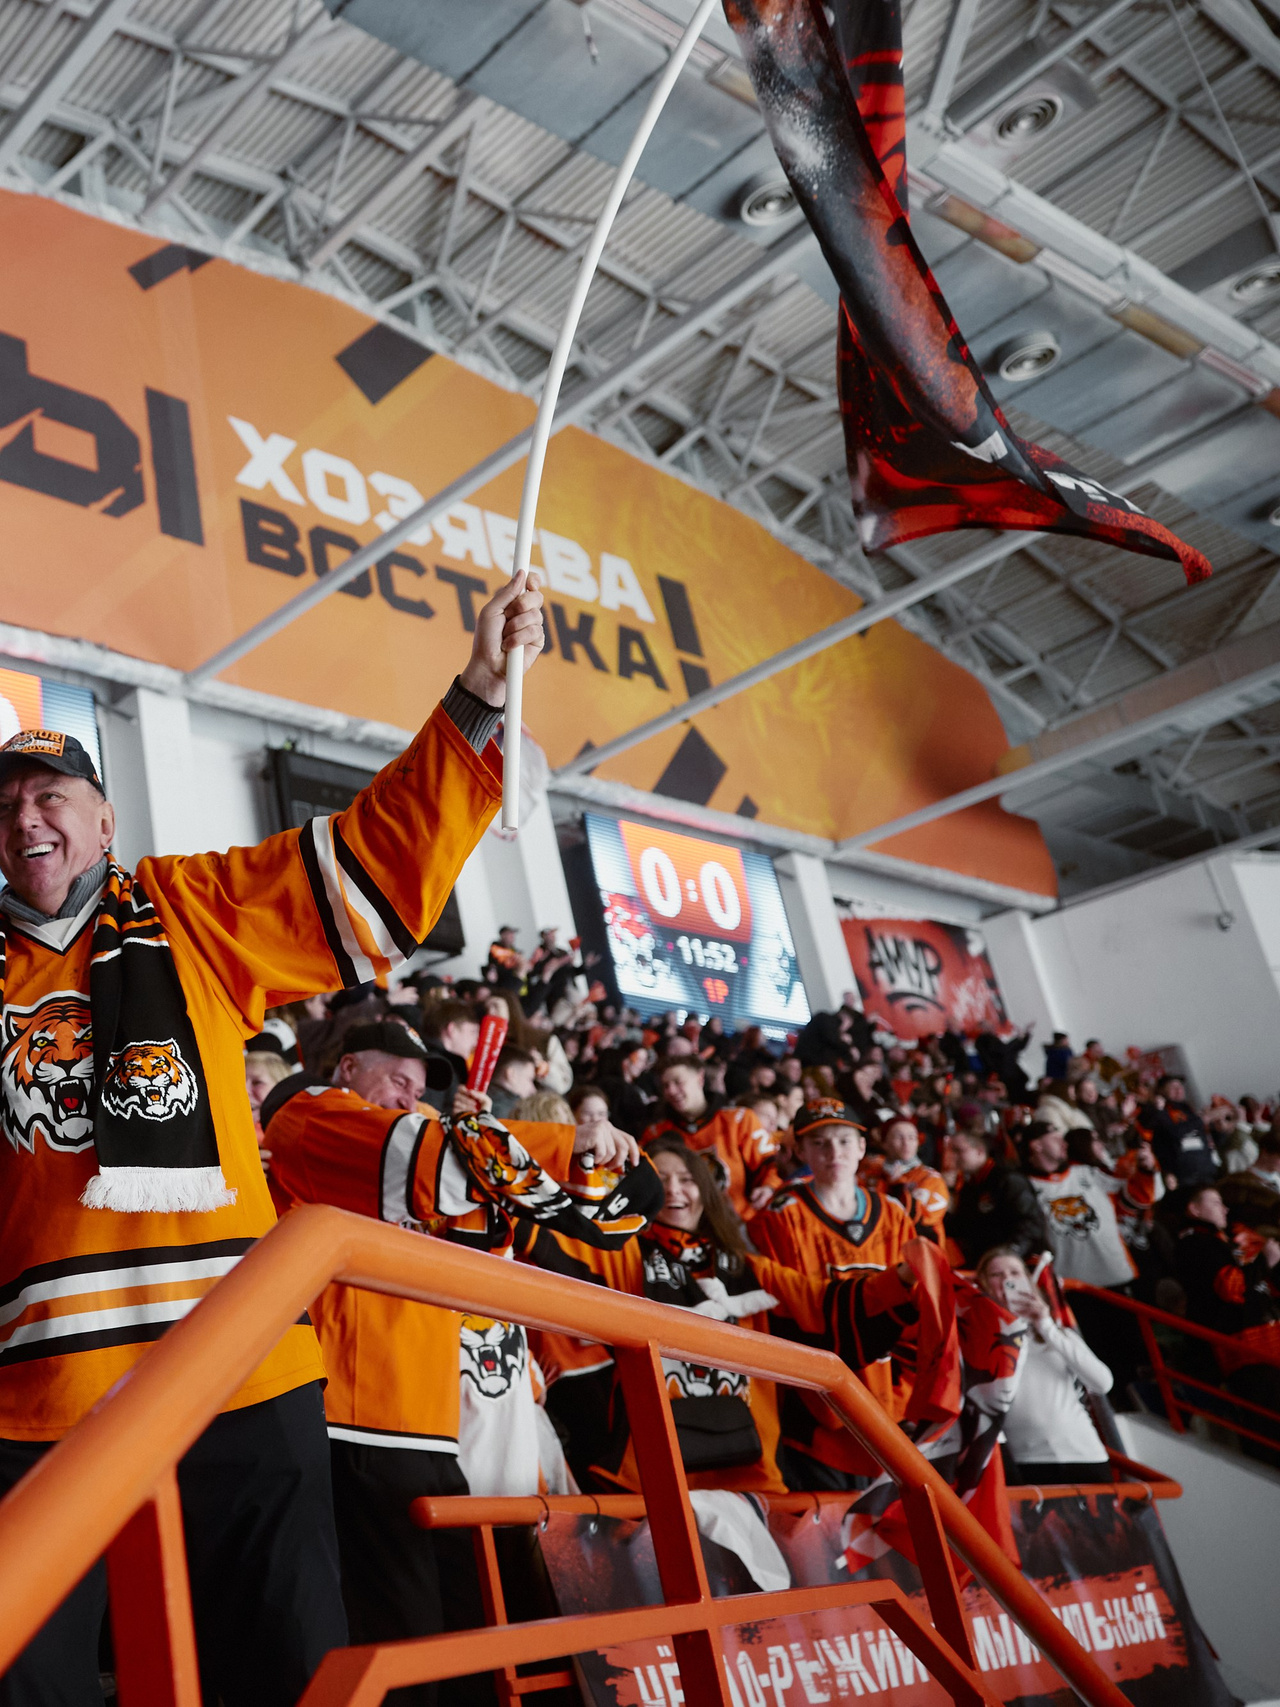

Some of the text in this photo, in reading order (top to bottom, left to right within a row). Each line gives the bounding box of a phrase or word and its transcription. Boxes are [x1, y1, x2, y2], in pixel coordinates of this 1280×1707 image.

[227, 415, 655, 623] ХОЗЯЕВА
[640, 847, 742, 931] 0:0
[677, 936, 738, 973] 11:52
